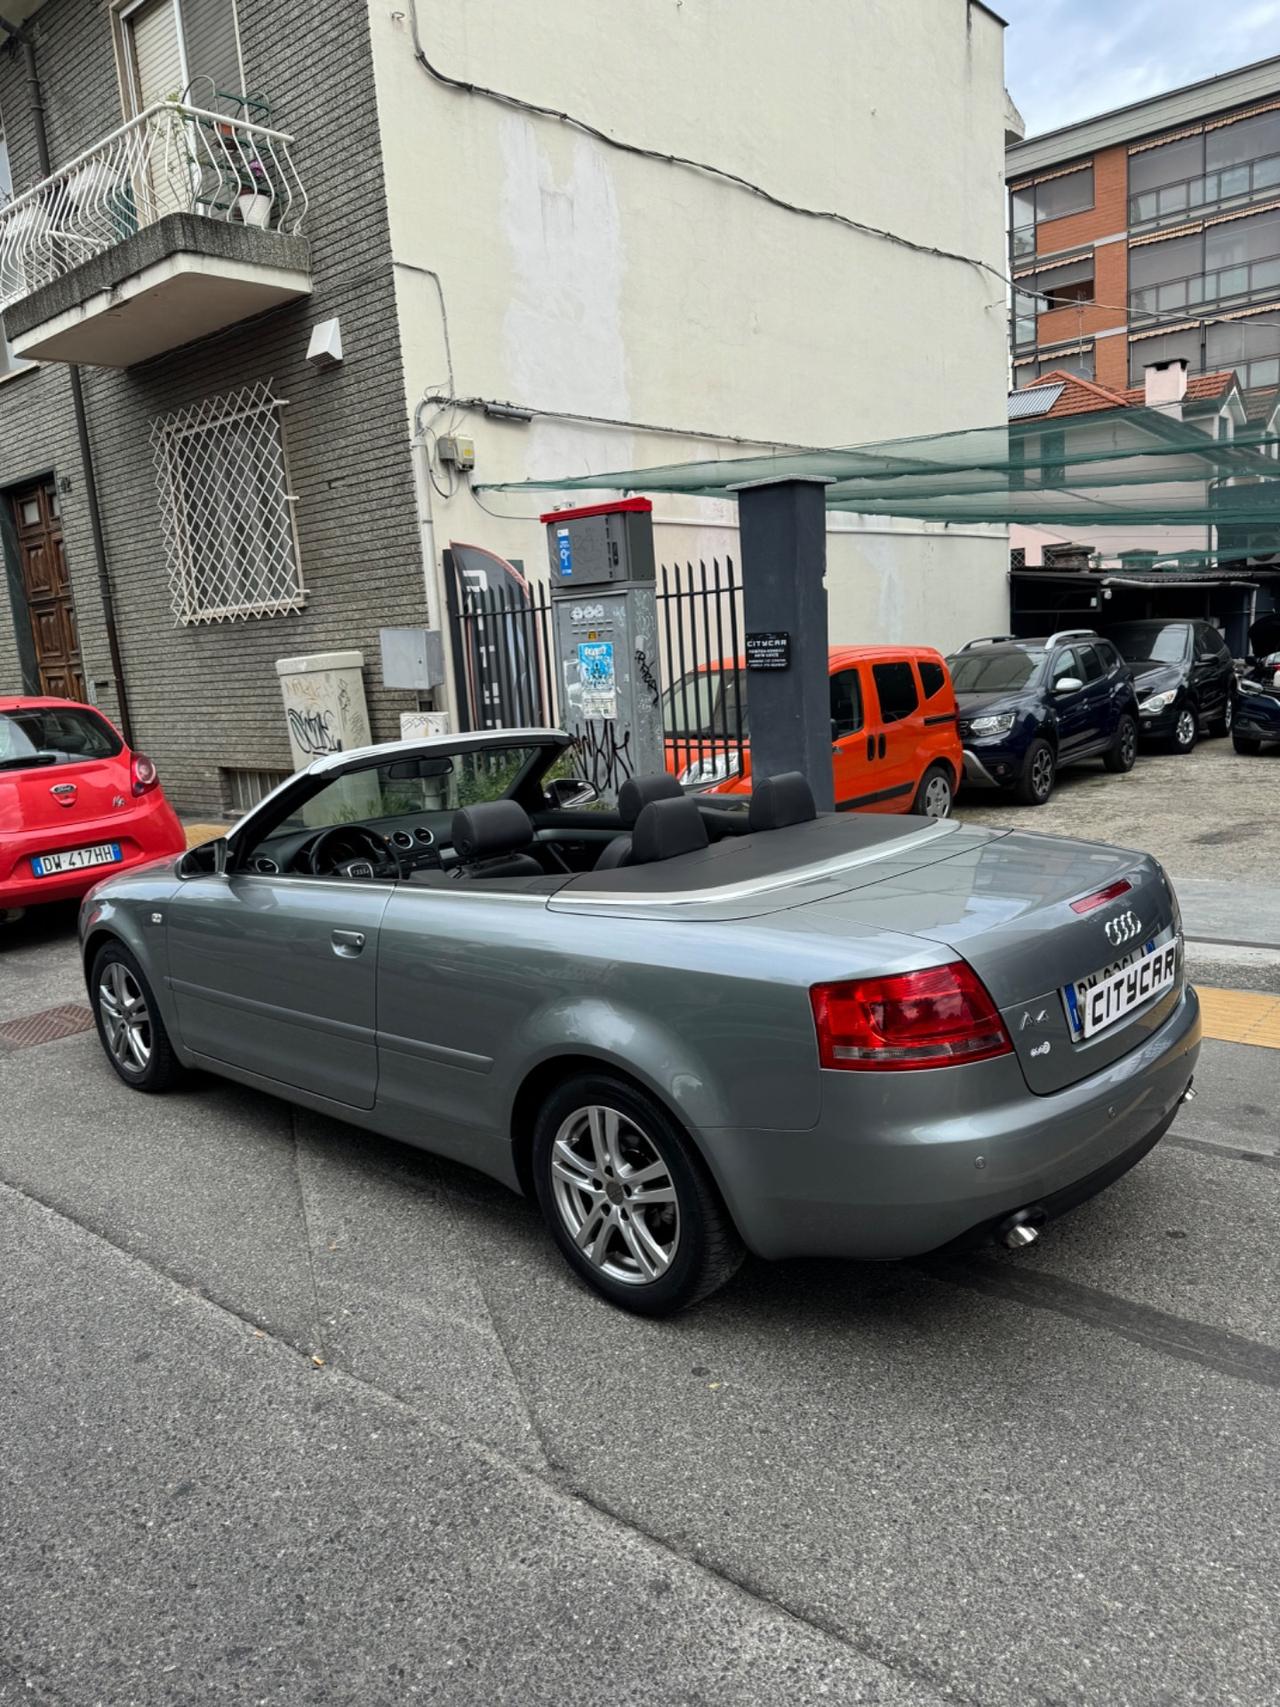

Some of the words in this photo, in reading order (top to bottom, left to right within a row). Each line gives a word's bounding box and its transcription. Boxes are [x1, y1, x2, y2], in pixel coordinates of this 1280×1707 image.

[43, 855, 62, 872] DW
[69, 846, 113, 867] 417HH
[1092, 947, 1175, 1027] CITYCAR
